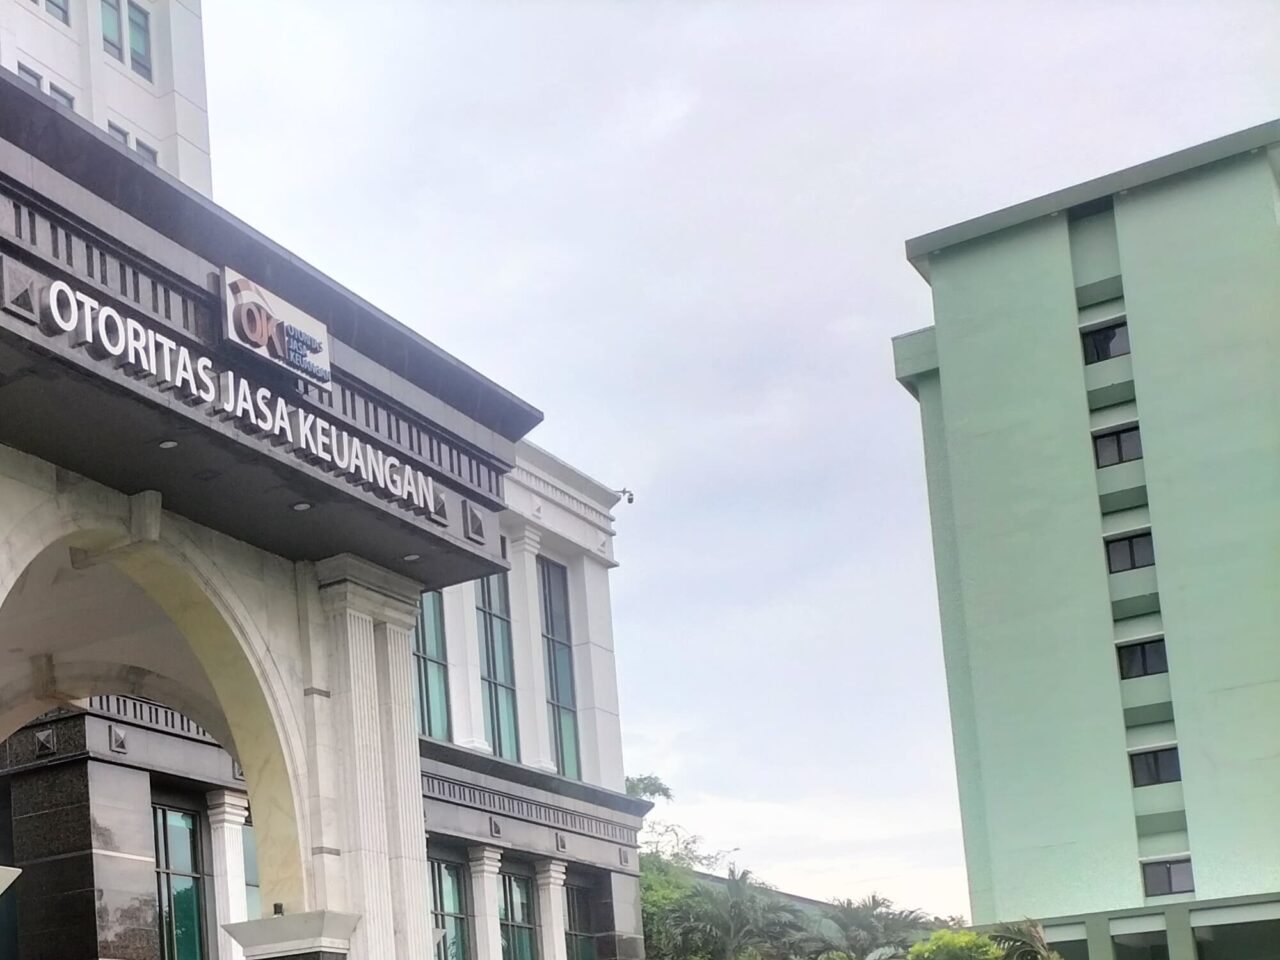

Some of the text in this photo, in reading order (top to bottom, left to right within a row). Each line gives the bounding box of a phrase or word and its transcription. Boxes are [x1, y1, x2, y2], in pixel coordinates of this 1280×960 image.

[289, 338, 307, 356] JASA
[289, 350, 331, 380] KEUANGAN
[50, 280, 435, 513] OTORITAS JASA KEUANGAN
